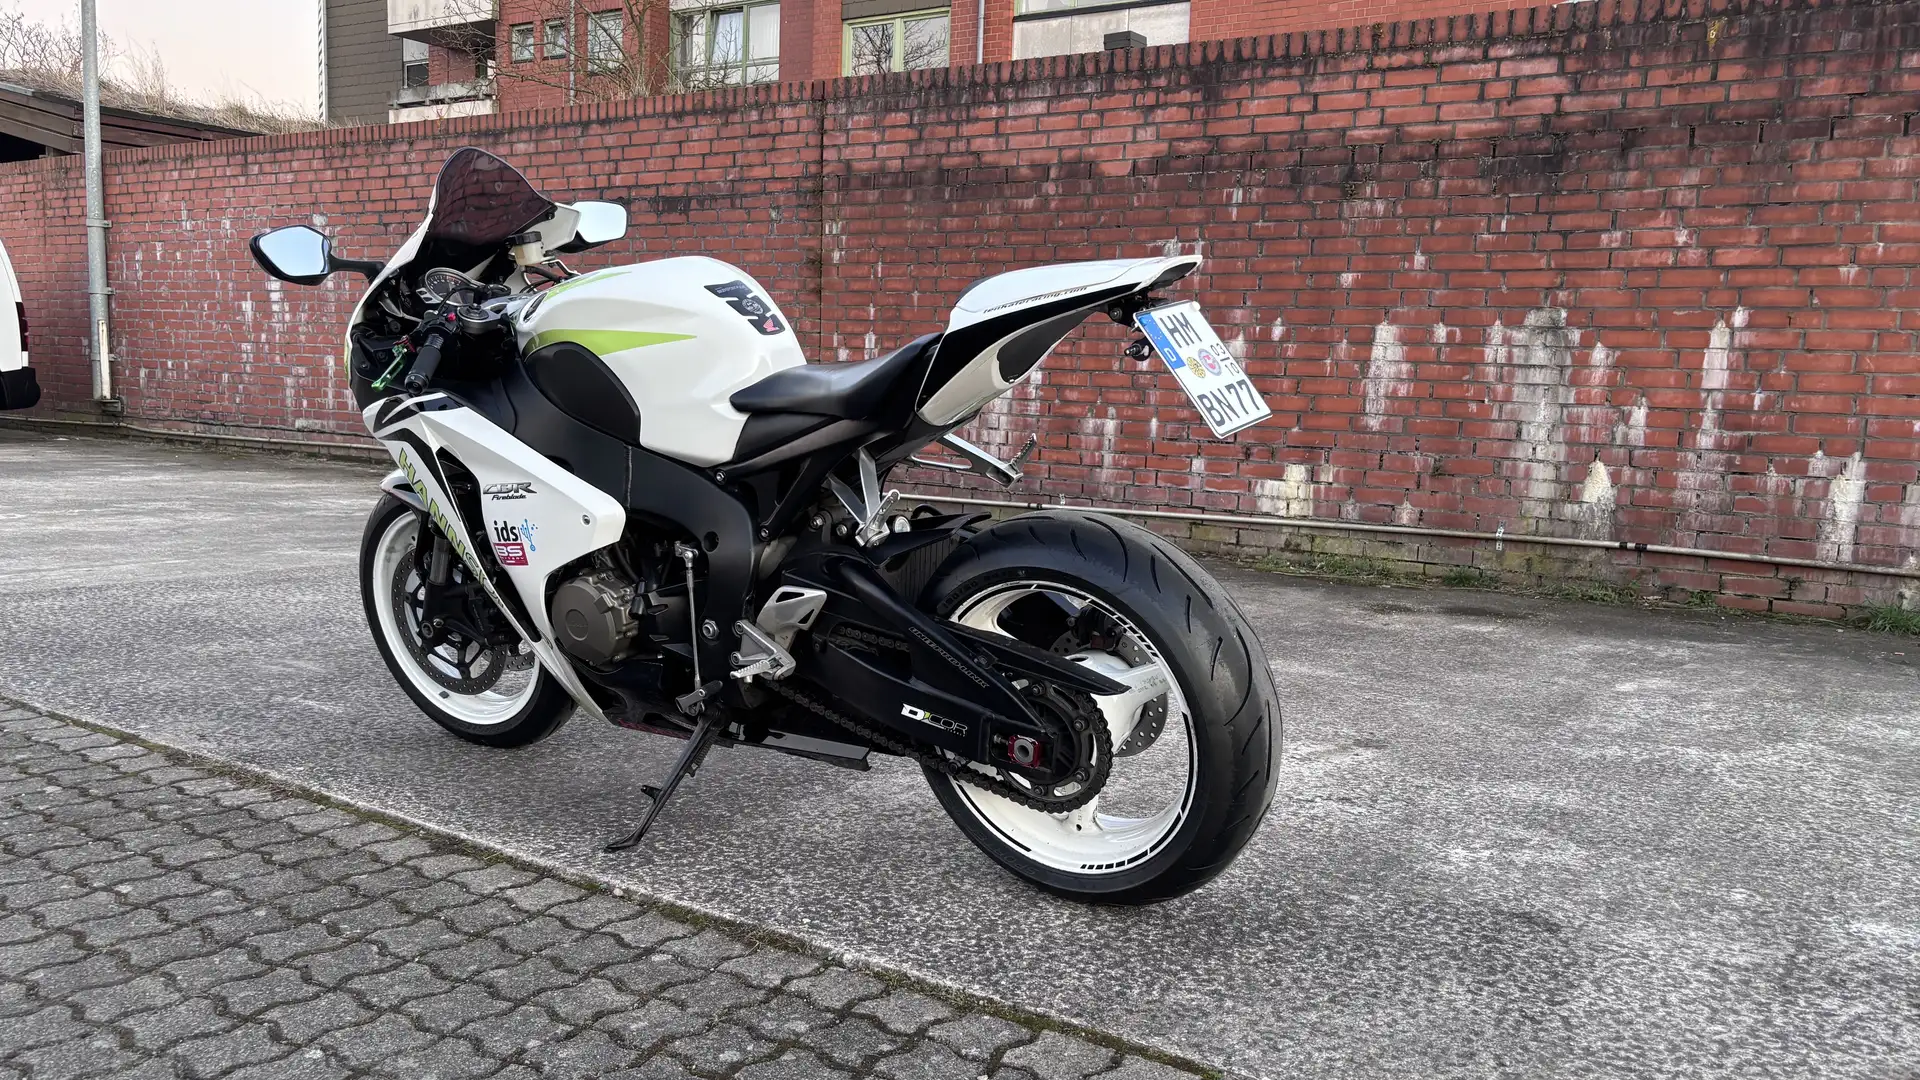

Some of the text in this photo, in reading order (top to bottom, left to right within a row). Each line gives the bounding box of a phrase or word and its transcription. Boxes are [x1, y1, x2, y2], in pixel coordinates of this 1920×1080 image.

[1159, 312, 1203, 349] HM
[1163, 347, 1177, 362] D
[1210, 343, 1227, 357] 03
[1196, 379, 1261, 428] BN77
[483, 482, 537, 495] CBR
[493, 520, 519, 542] ids
